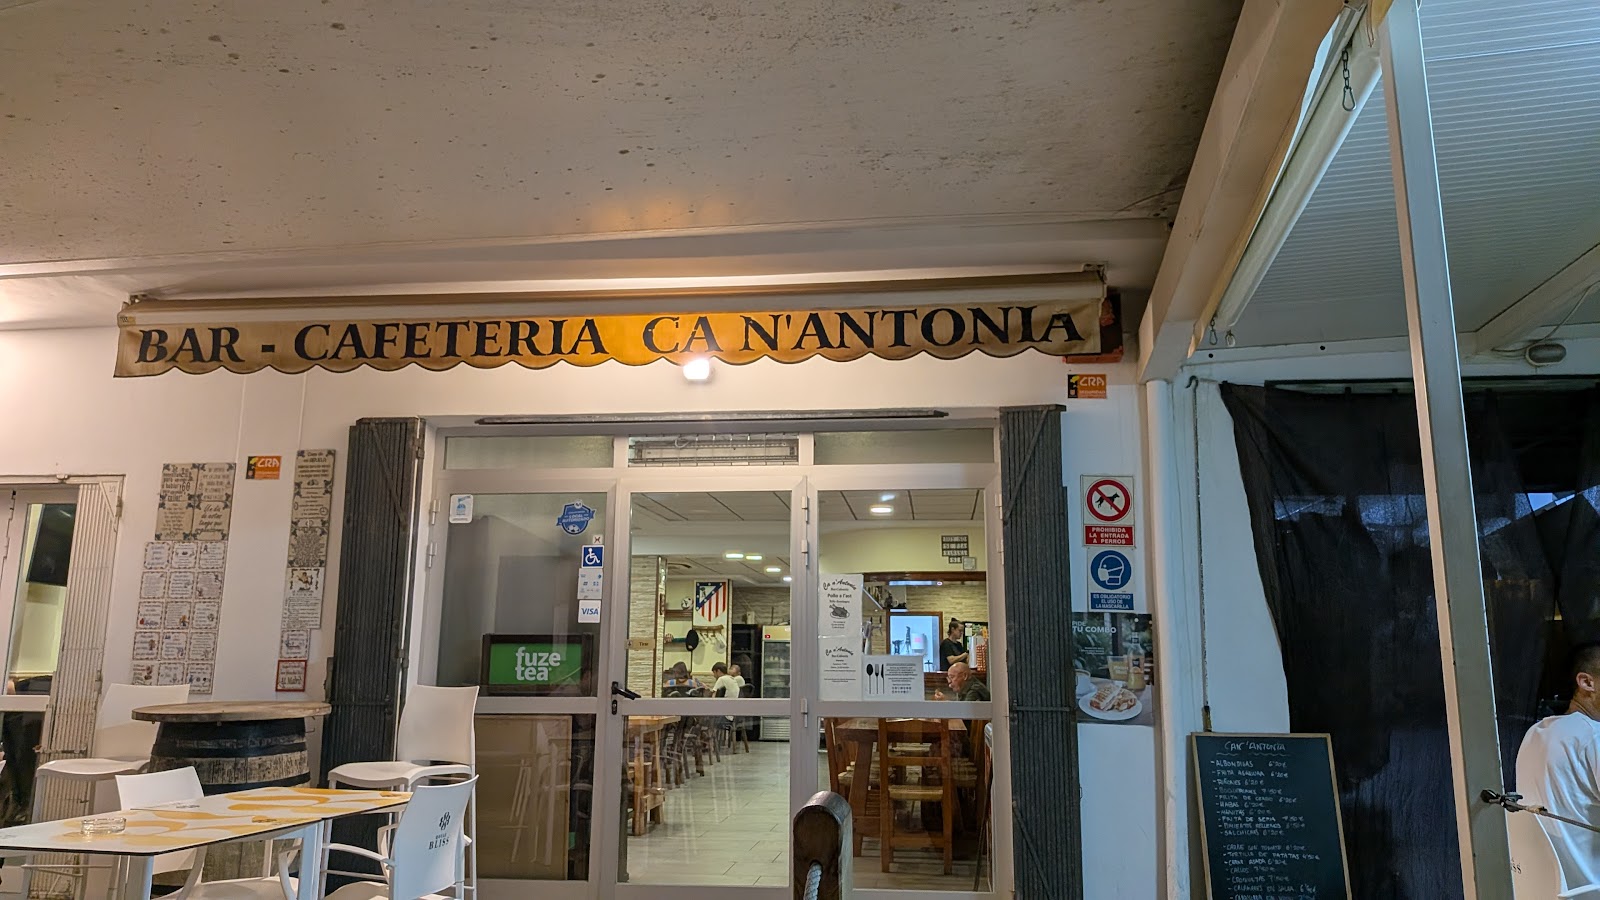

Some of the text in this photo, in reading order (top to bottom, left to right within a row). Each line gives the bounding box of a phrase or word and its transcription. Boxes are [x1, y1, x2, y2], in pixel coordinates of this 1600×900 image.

[135, 327, 245, 364] BAR
[294, 318, 609, 361] CAFETERIA
[642, 315, 724, 354] CA
[738, 305, 1085, 352] N'ANTONIA
[515, 646, 561, 667] fuze
[515, 664, 549, 681] tea
[428, 836, 450, 849] BLISS
